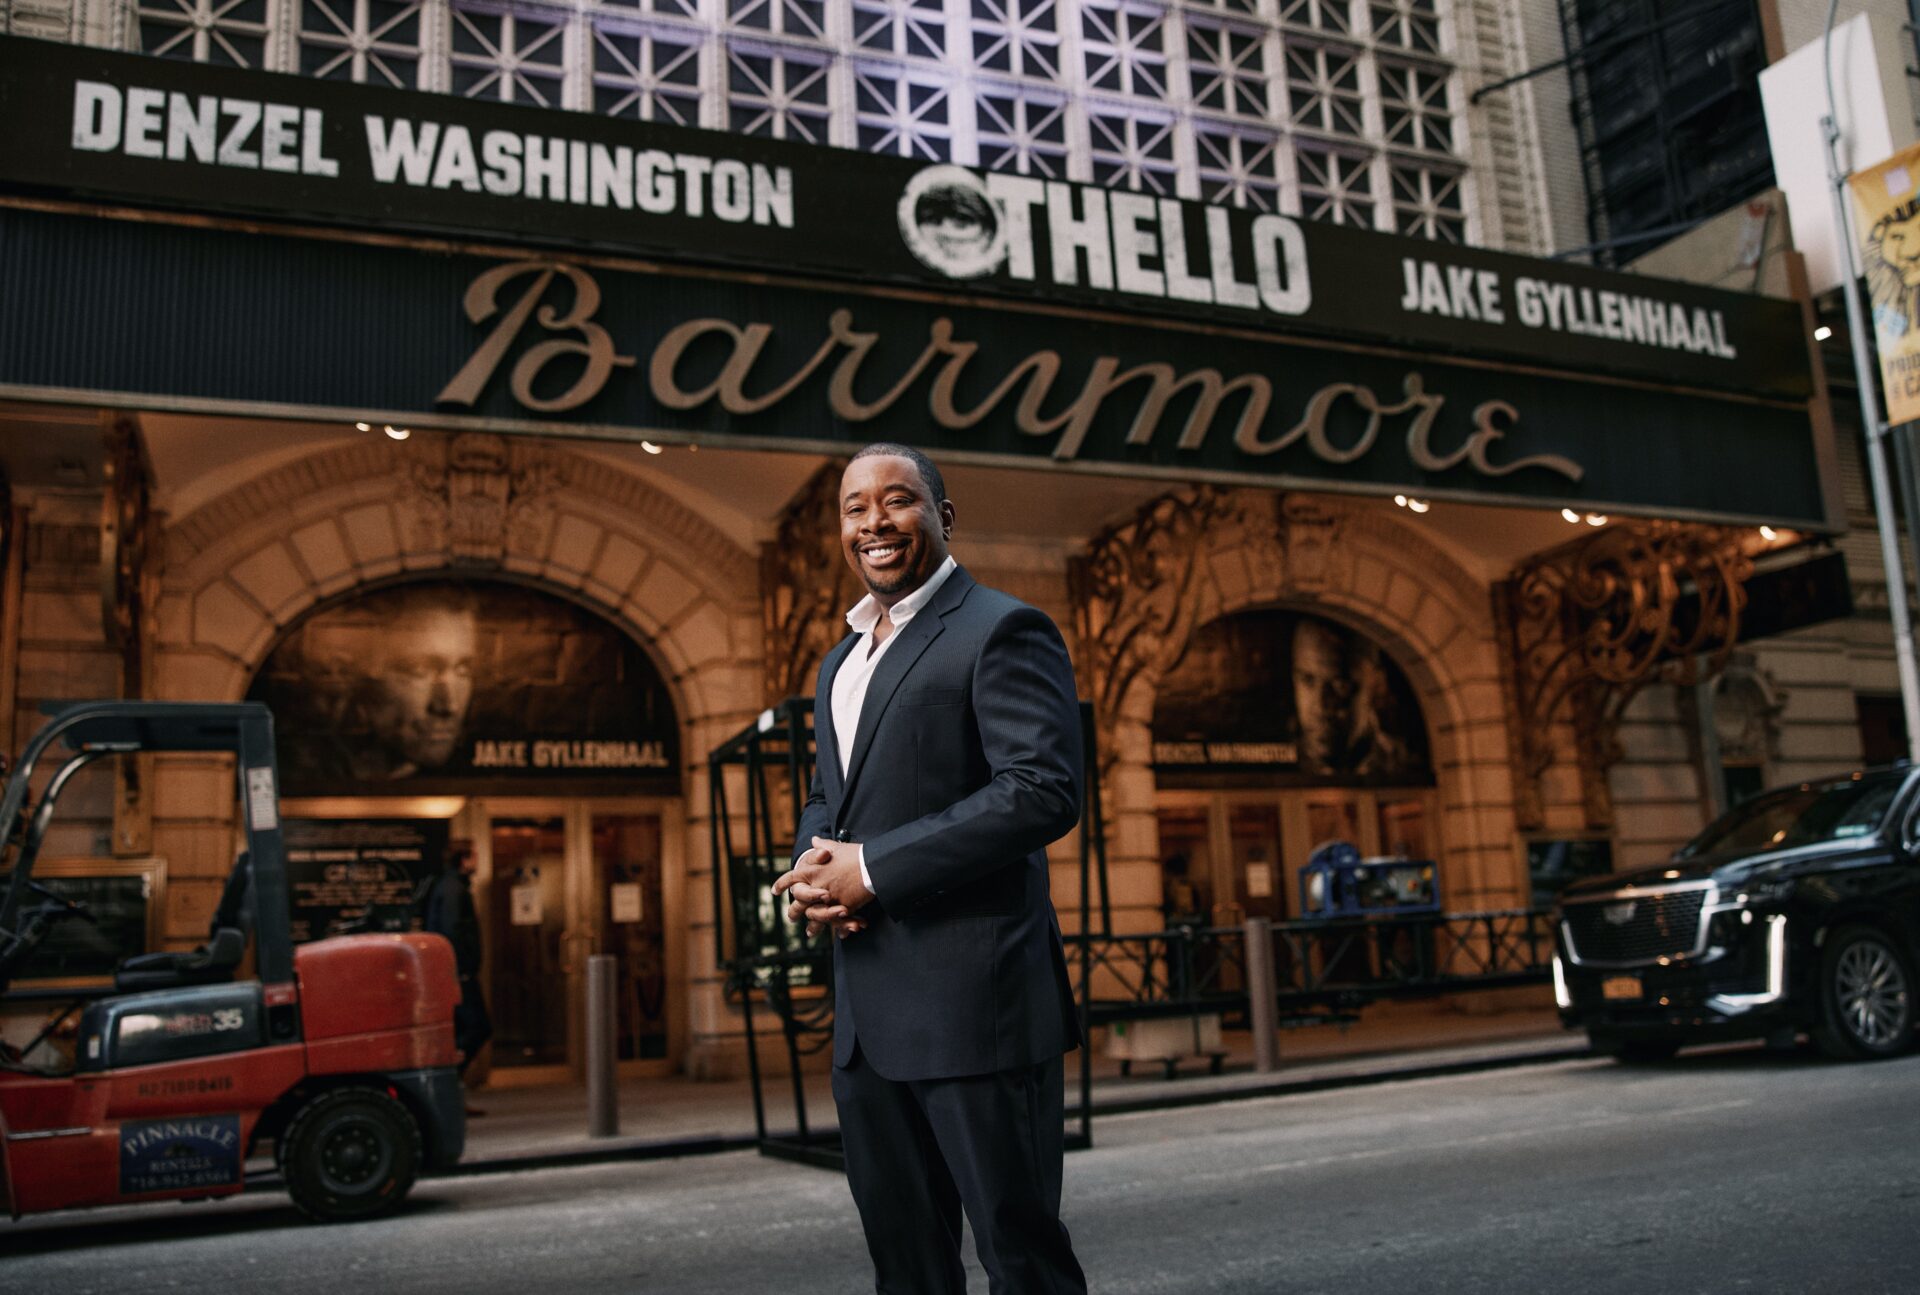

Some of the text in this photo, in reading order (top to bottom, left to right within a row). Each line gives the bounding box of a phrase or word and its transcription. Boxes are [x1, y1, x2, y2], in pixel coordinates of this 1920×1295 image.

[72, 80, 795, 228] DENZEL WASHINGTON
[897, 164, 1312, 316] OTHELLO
[1402, 258, 1738, 360] JAKE GYLLENHAAL
[435, 262, 1584, 482] Barrymore
[472, 740, 668, 767] JAKE GYLLENHAAL
[213, 1008, 244, 1031] 35
[124, 1123, 236, 1156] PINNACLE
